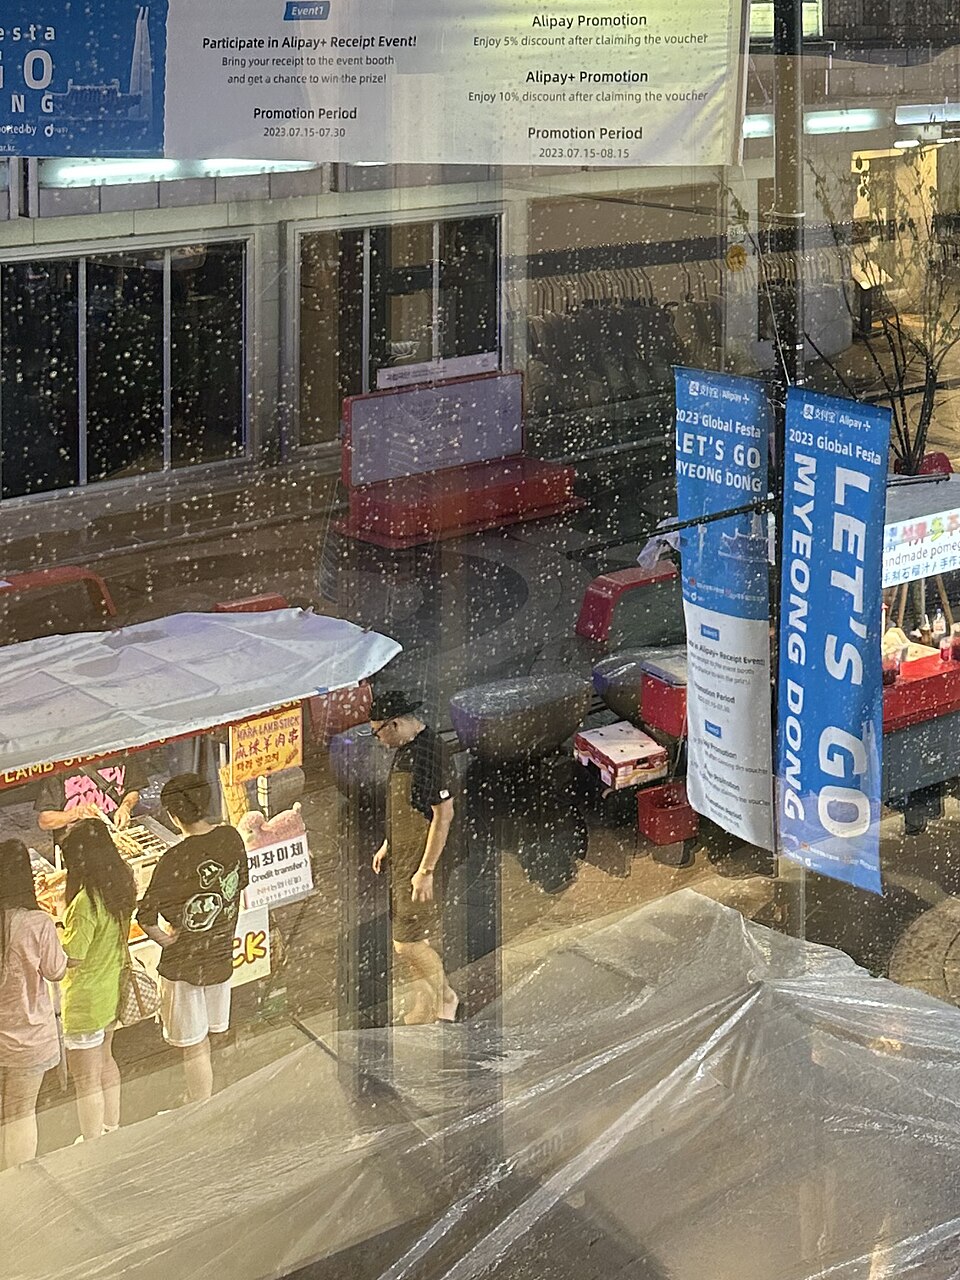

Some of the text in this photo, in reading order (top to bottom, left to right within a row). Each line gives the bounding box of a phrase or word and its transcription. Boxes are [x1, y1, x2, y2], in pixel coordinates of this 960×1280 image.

[292, 6, 324, 16] Event1
[532, 14, 647, 29] Alipay Promotion
[203, 35, 417, 51] Participate in Alipay+ Receipt Event!
[473, 33, 708, 48] Enjoy 5% discount after claiming the voucher
[222, 55, 394, 68] Bring your receipt to the event booth
[0, 49, 53, 90] O
[227, 74, 245, 84] and
[248, 75, 262, 86] get
[273, 74, 306, 84] chance
[309, 75, 319, 84] to
[322, 74, 338, 83] win
[341, 74, 357, 83] the
[359, 73, 386, 85] prize!
[526, 70, 648, 85] Alipay+ Promotion
[468, 90, 709, 103] Enjoy 10% discount after claiming the voucher
[254, 107, 357, 120] Promotion Period
[264, 127, 346, 138] 2023.07.15-07.30
[528, 127, 642, 140] Promotion Period
[539, 148, 630, 159] 2023.07.15-08.15
[702, 414, 732, 432] Global
[736, 421, 761, 439] Festa
[789, 429, 881, 465] 2023 Global Festa
[733, 442, 761, 470] GO
[726, 472, 761, 493] DONG
[787, 453, 817, 667] MYEONG
[825, 466, 871, 687] LET'S
[784, 678, 804, 822] DONG
[818, 725, 871, 838] GO
[252, 870, 274, 884] Credit
